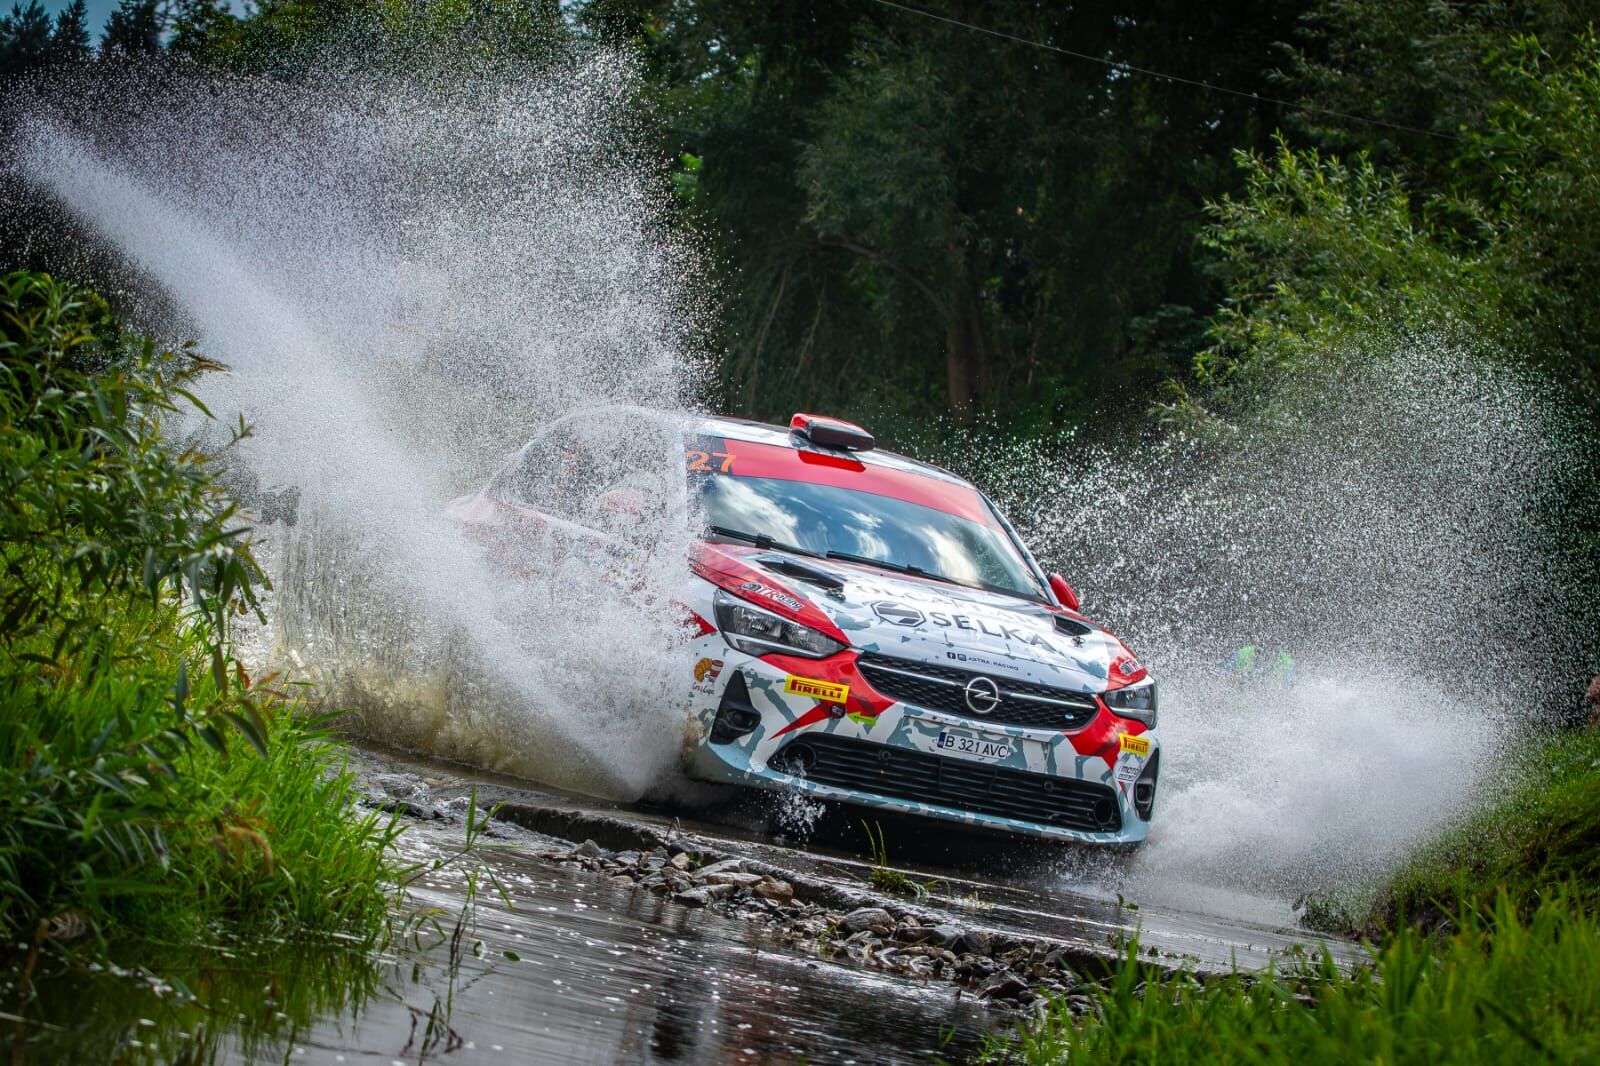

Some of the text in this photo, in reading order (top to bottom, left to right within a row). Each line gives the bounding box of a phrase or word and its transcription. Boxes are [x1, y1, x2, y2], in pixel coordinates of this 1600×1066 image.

[687, 451, 737, 473] 27
[931, 611, 1057, 652] SELKA
[789, 679, 844, 699] PIRELLI
[945, 735, 1007, 758] B 321 AVC
[1123, 736, 1148, 753] PIRELLI
